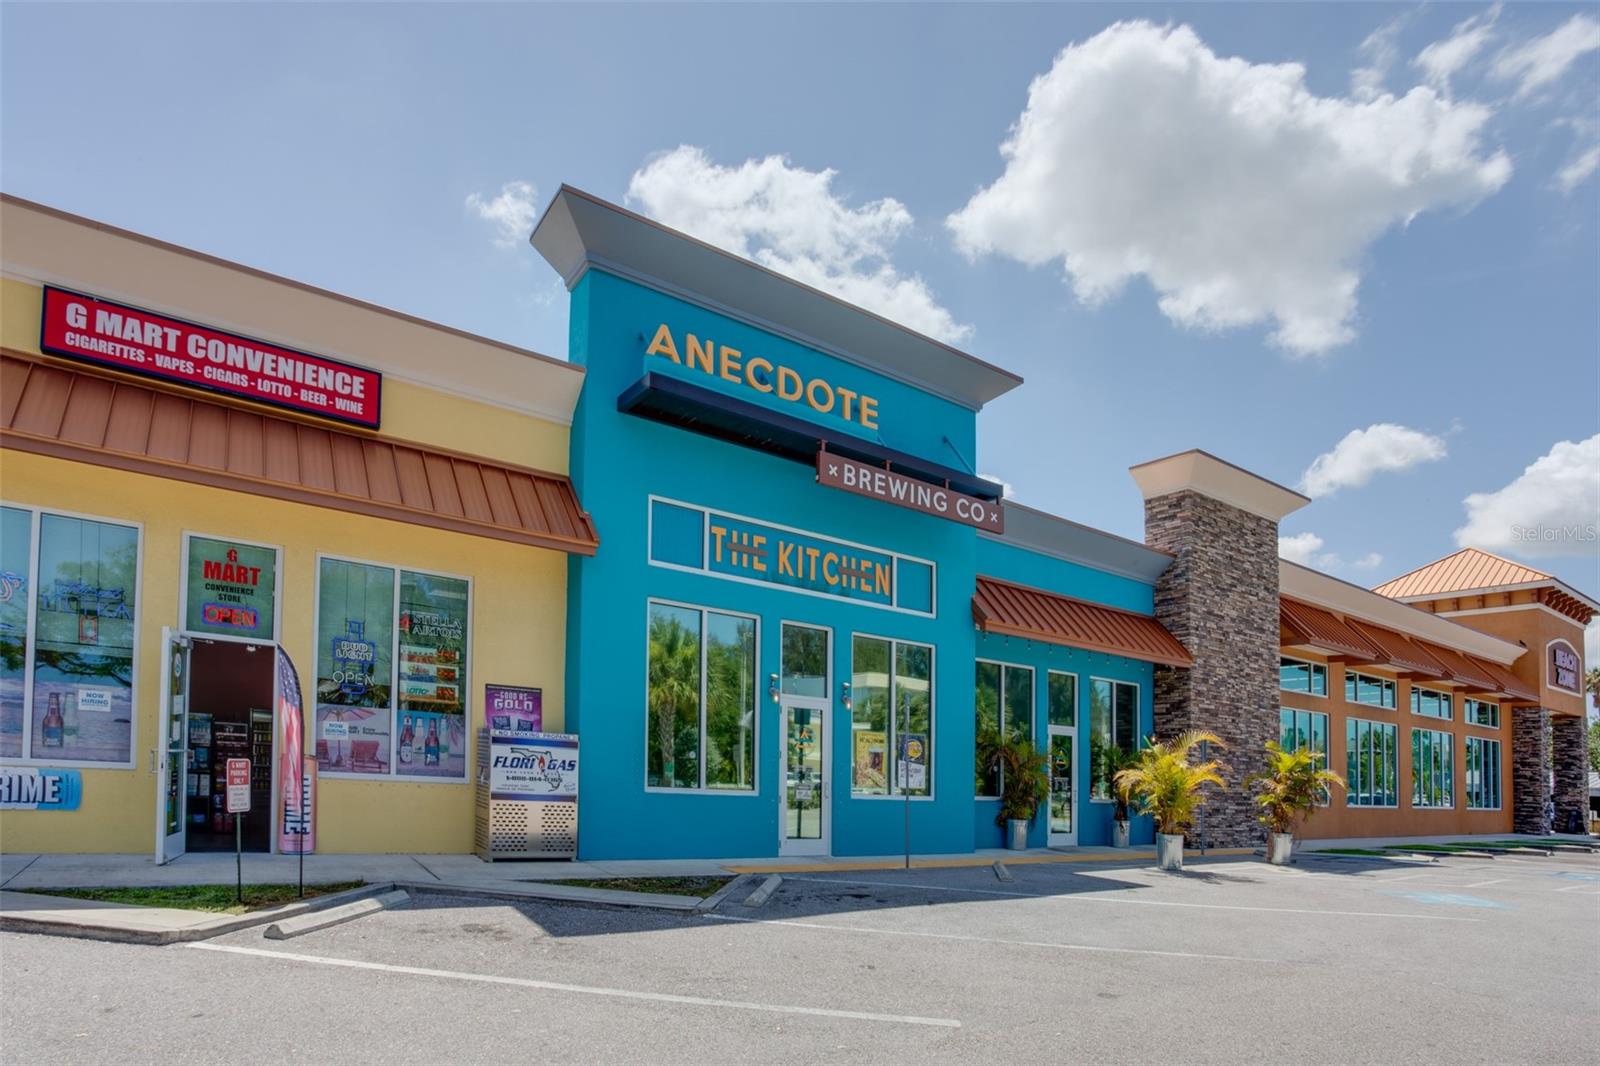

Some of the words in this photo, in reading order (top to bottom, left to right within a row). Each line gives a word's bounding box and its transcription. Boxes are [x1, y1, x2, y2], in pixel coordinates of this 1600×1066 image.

[66, 303, 87, 329] G
[95, 309, 181, 352] MART
[187, 334, 365, 398] CONVENIENCE
[65, 331, 145, 363] CIGARETTES
[155, 354, 194, 374] VAPES
[203, 365, 248, 387] CIGARS
[257, 378, 291, 398] LOTTO
[300, 389, 327, 406] BEER
[335, 397, 363, 415] WINE
[646, 323, 879, 430] ANECDOTE
[843, 463, 947, 512] BREWING
[956, 498, 985, 522] CO
[227, 548, 238, 563] G
[711, 526, 767, 572] THE
[778, 540, 890, 596] KITCHEN
[203, 560, 261, 586] MART
[205, 582, 254, 596] CONVENIENCE
[218, 593, 241, 603] STORE
[205, 605, 256, 627] OPEN
[413, 613, 462, 630] STELLA
[412, 625, 462, 639] ARTOIS
[341, 641, 368, 652] BUD
[336, 649, 373, 661] LIGHT
[333, 671, 375, 686] OPEN
[81, 698, 108, 706] HIRING
[500, 691, 517, 700] GOOD
[494, 698, 533, 712] GOLD
[493, 756, 536, 769] FLORI
[547, 759, 577, 772] GAS
